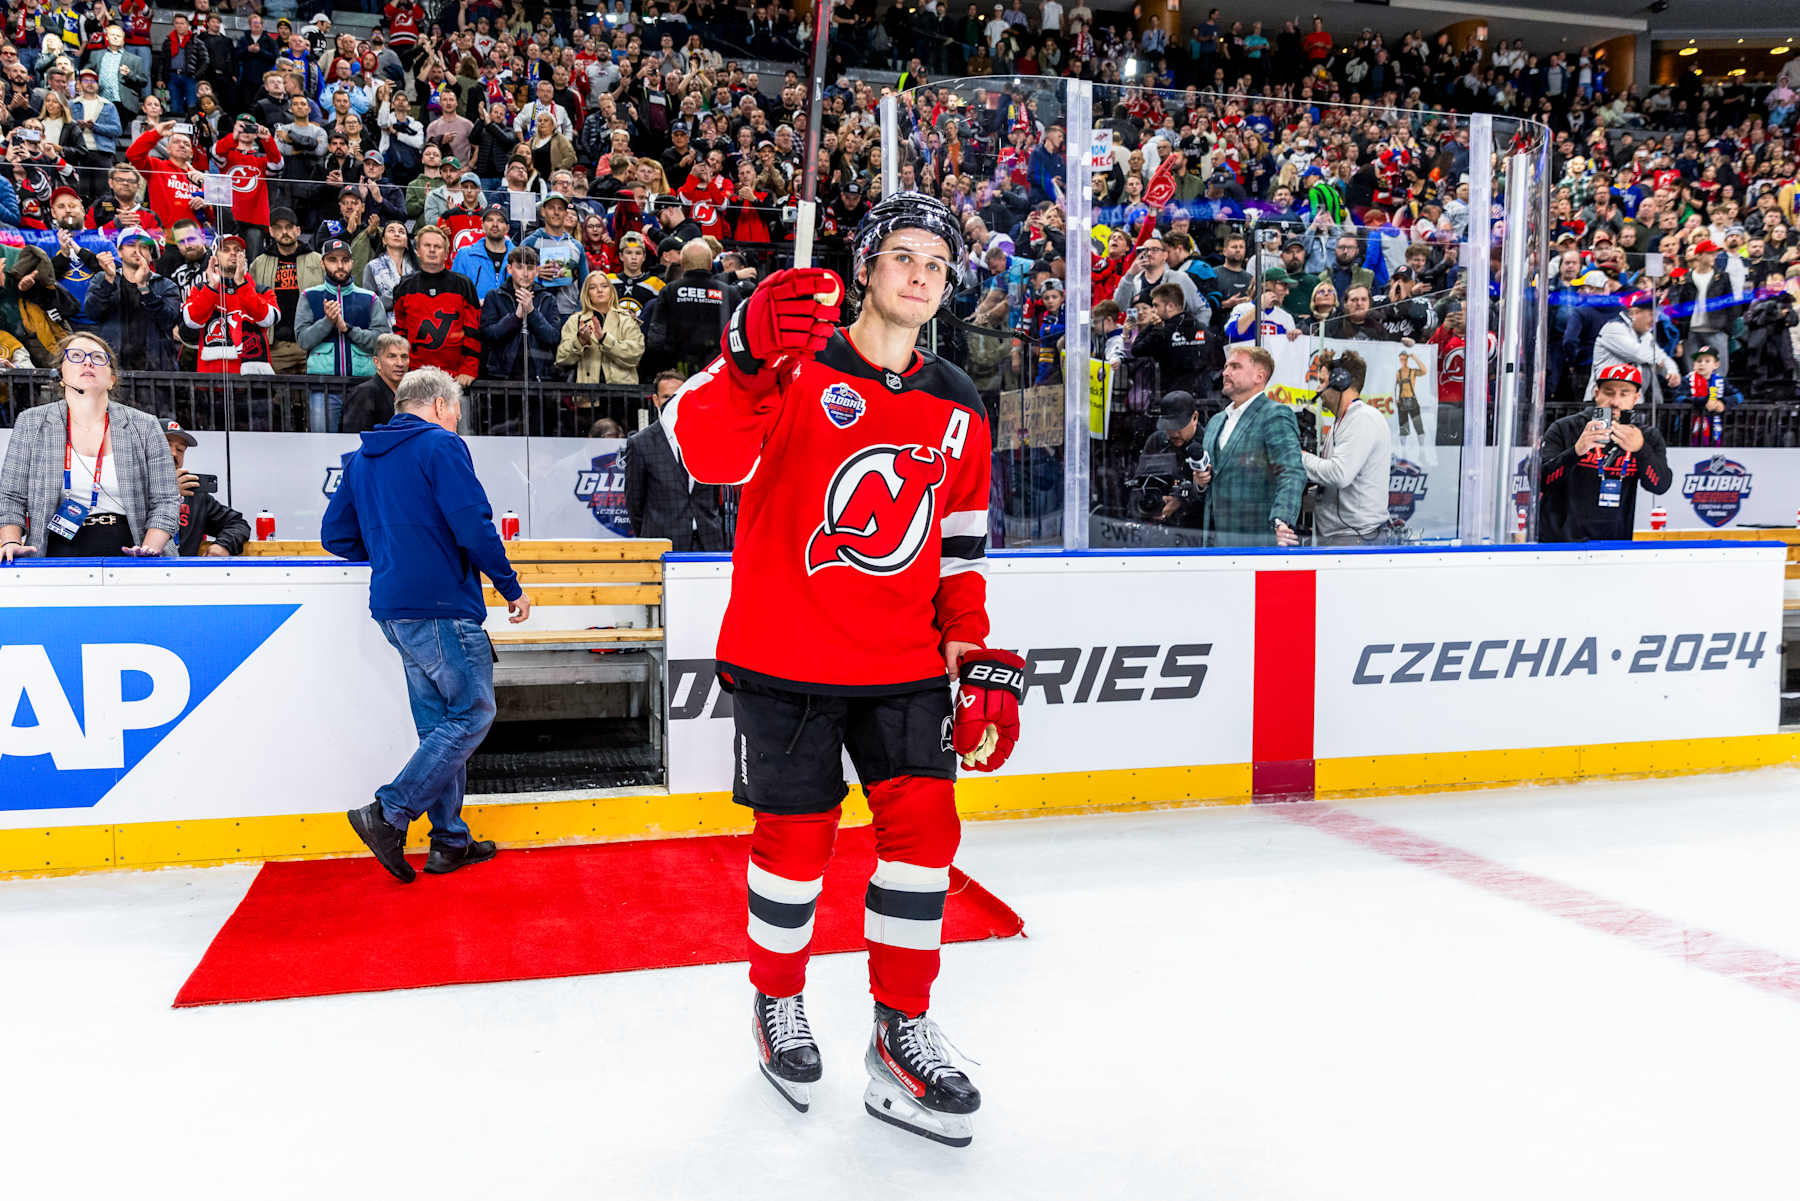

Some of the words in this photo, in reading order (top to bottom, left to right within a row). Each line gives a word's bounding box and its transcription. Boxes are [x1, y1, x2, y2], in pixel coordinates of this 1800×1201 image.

[677, 286, 707, 299] CEE
[823, 391, 865, 412] GLOBAL
[940, 406, 971, 460] A
[575, 471, 627, 495] GLO
[1388, 473, 1427, 496] BAL
[1682, 474, 1752, 495] GLOBAL
[1352, 636, 1598, 686] CZECHIA
[1627, 631, 1768, 674] 2024
[1008, 643, 1214, 706] RIES
[888, 1060, 919, 1092] BAUER
